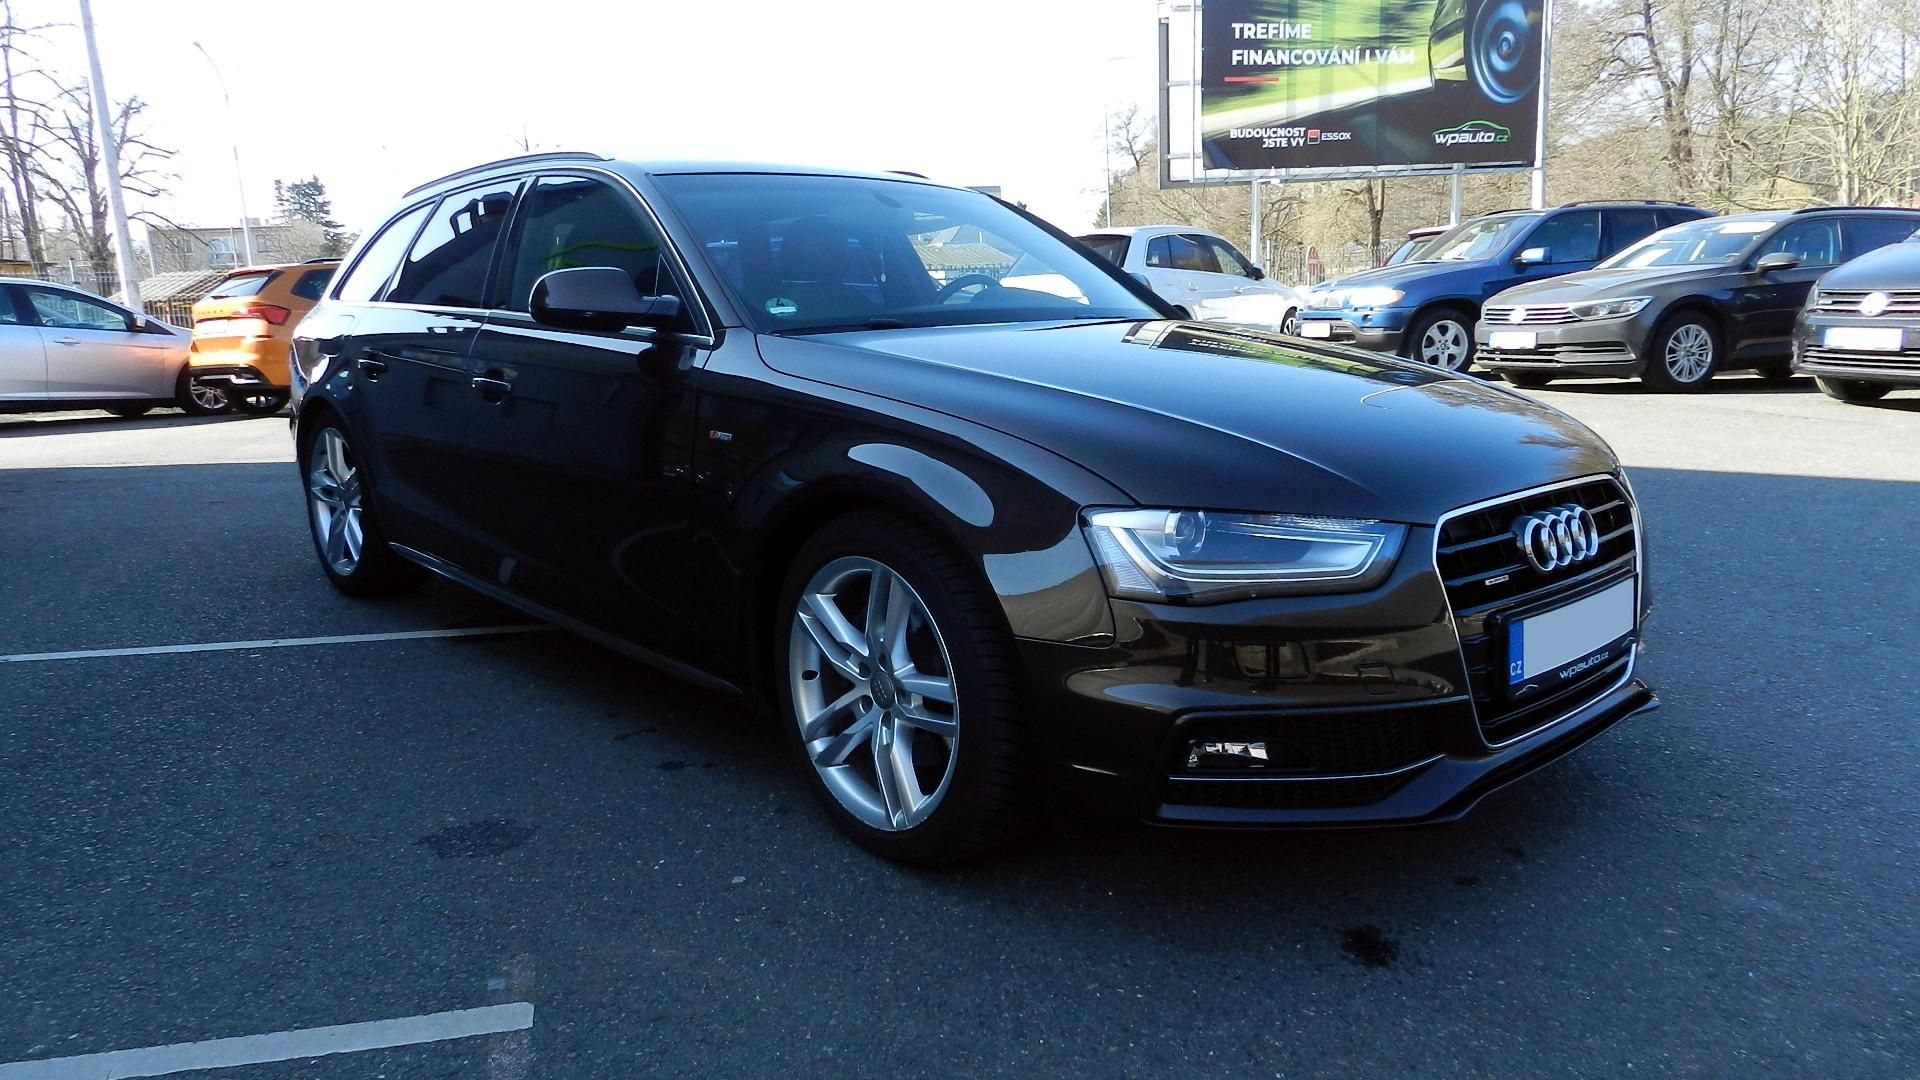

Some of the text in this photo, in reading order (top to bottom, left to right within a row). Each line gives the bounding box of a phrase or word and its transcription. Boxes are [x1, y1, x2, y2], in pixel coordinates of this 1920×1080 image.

[1231, 19, 1312, 39] TREFÍME
[1231, 43, 1416, 65] FINANCOVÁNÍ I VÁM
[1229, 128, 1306, 139] BUDOUCNOST
[1321, 132, 1352, 141] ESSOX
[1262, 137, 1306, 148] JSTE VY
[1510, 661, 1522, 676] CZ
